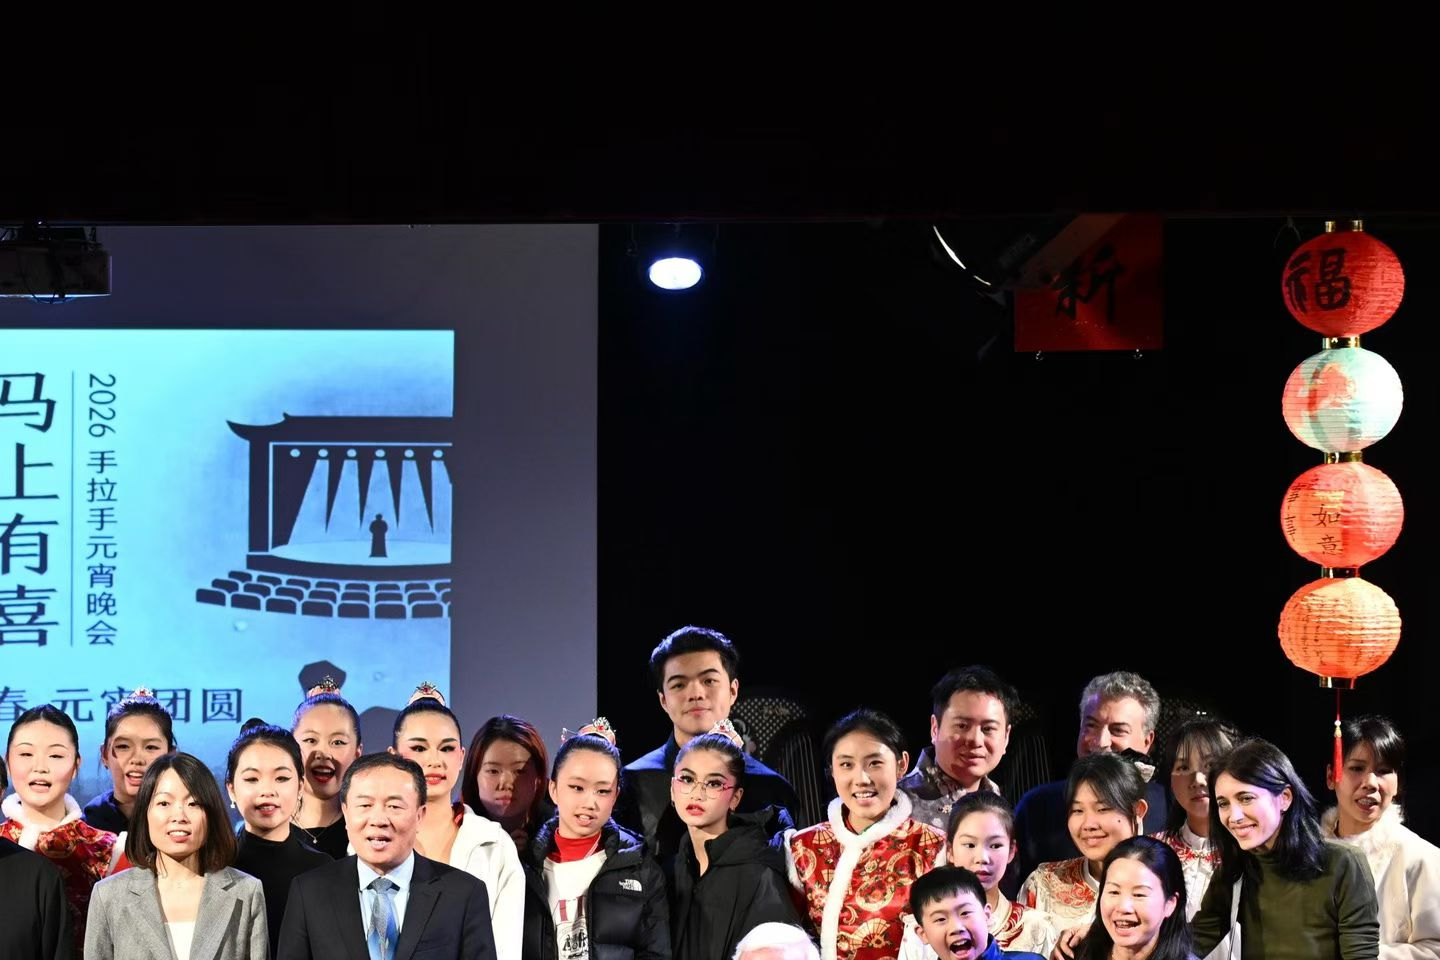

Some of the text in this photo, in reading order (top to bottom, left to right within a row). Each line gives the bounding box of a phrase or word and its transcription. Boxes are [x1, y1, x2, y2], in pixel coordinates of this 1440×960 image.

[1286, 248, 1351, 314] 福
[86, 373, 118, 646] 2026 手拉手元宵晚会
[1311, 503, 1343, 555] 如意
